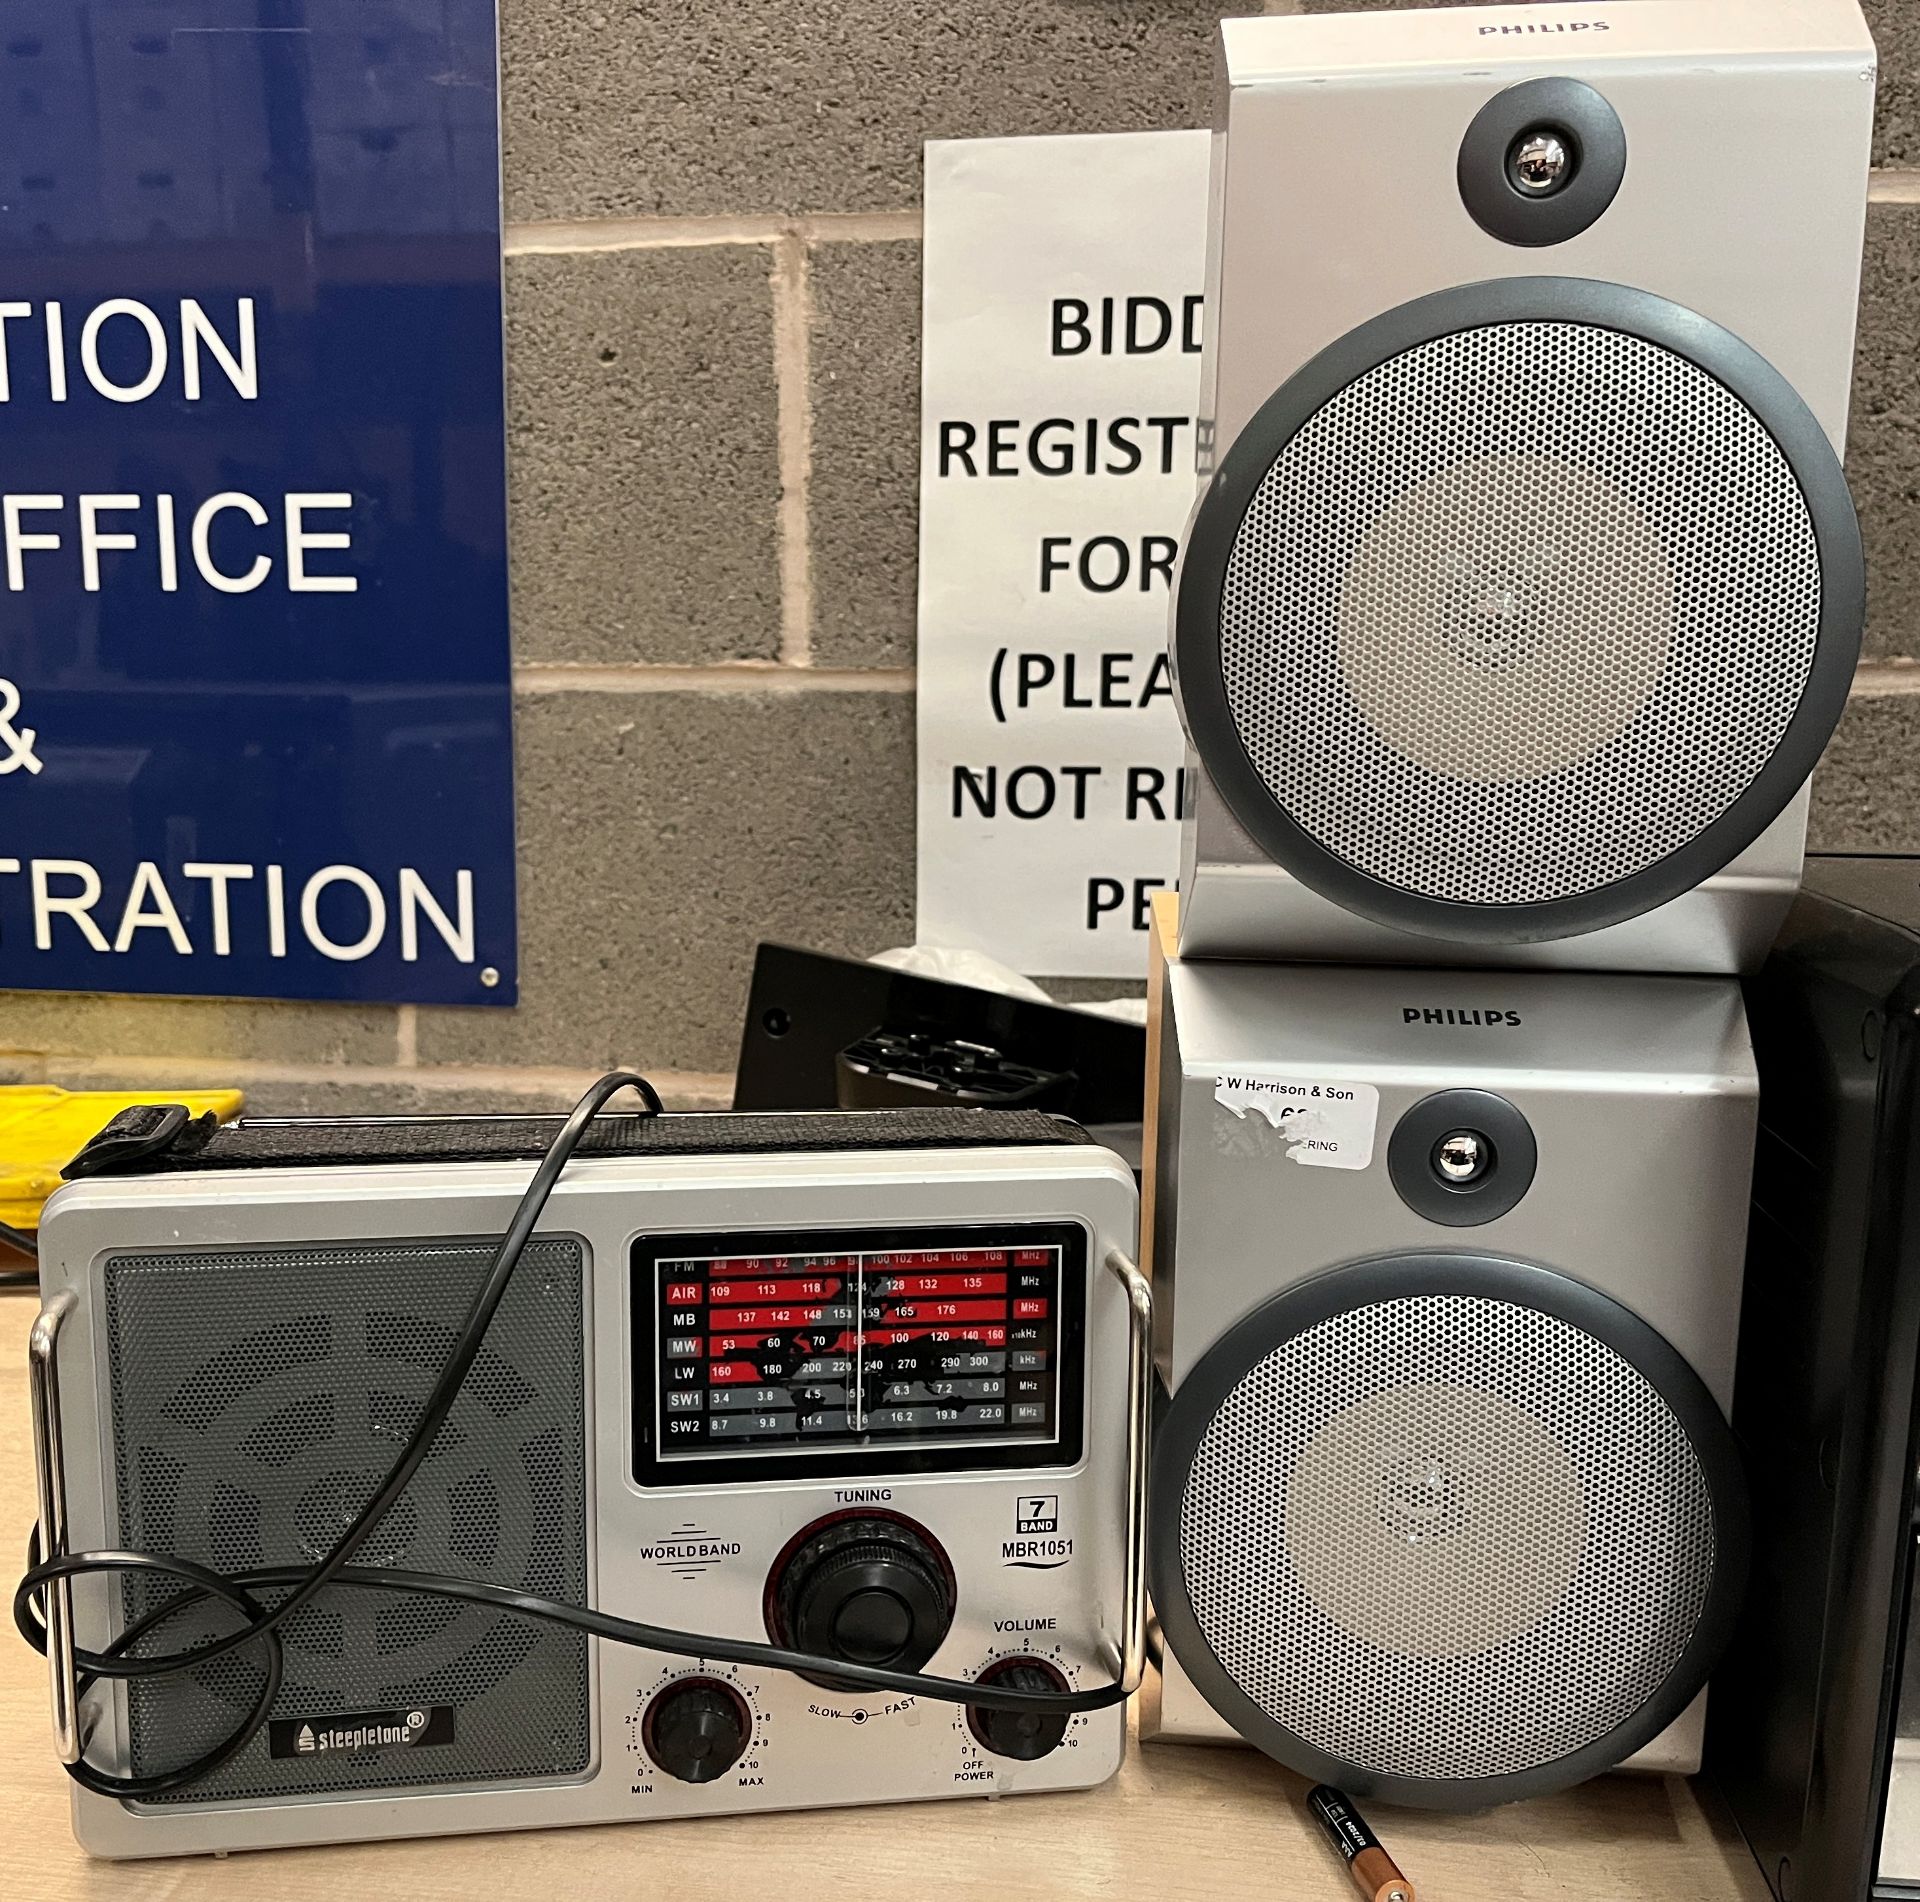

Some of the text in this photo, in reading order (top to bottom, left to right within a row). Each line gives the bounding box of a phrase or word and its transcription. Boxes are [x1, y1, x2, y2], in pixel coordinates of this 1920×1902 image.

[1479, 21, 1610, 35] PHILIPS
[938, 416, 1201, 478] REGIST
[3, 492, 358, 592] FFICE
[951, 766, 1184, 820] NOT R
[0, 858, 475, 962] RATION
[1087, 878, 1179, 930] PE
[1403, 1008, 1521, 1026] PHILIPS
[1227, 1077, 1241, 1089] W
[1245, 1079, 1306, 1096] Harrison
[1311, 1086, 1321, 1097] &
[1326, 1087, 1354, 1100] Son
[922, 1252, 940, 1263] 104
[951, 1252, 969, 1262] 106
[985, 1250, 1003, 1261] 108
[671, 1286, 697, 1300] AIR
[710, 1286, 730, 1297] 109
[758, 1285, 776, 1295] 113
[802, 1283, 821, 1293] 118
[886, 1280, 905, 1291] 128
[919, 1279, 938, 1289] 132
[963, 1278, 983, 1288] 135
[1021, 1276, 1040, 1287] MHz
[673, 1313, 696, 1326] MB
[737, 1312, 757, 1323] 137
[771, 1311, 790, 1321] 142
[803, 1309, 822, 1320] 148
[895, 1306, 914, 1317] 165
[936, 1305, 956, 1315] 176
[1020, 1303, 1039, 1313] MHz
[672, 1340, 697, 1353] MW
[722, 1340, 736, 1350] 53
[767, 1338, 781, 1348] 60
[813, 1336, 826, 1346] 70
[890, 1333, 909, 1343] 100
[930, 1331, 950, 1342] 120
[962, 1331, 979, 1340] 140
[987, 1329, 1004, 1340] 160
[674, 1354, 1036, 1380] LW 160 180 200 220 240 270 290 300 kHz
[671, 1393, 699, 1406] SW1
[713, 1392, 730, 1404] 3.4
[757, 1391, 774, 1402] 3.8
[804, 1389, 821, 1400] 4.5
[893, 1385, 910, 1396] 6.3
[936, 1384, 953, 1395] 7.2
[983, 1382, 1000, 1393] 8.0
[1019, 1381, 1038, 1391] MHz
[670, 1420, 700, 1433] SW2
[711, 1419, 728, 1431] 8.7
[759, 1417, 776, 1428] 9.8
[801, 1415, 823, 1427] 11.4
[891, 1411, 913, 1423] 16.2
[935, 1409, 958, 1421] 19.8
[979, 1408, 1002, 1420] 22.0
[1019, 1407, 1038, 1417] MHz
[834, 1488, 892, 1503] TUNING
[1030, 1501, 1045, 1517] 7
[1020, 1521, 1054, 1532] BAND
[1002, 1539, 1073, 1558] MBR1051
[994, 1618, 1057, 1632] VOLUME
[1023, 1637, 1030, 1647] 5
[987, 1646, 994, 1655] 4
[1055, 1644, 1061, 1653] 6
[661, 1667, 668, 1676] 4
[732, 1665, 738, 1673] 6
[963, 1669, 968, 1677] 3
[1076, 1665, 1082, 1674] 7
[636, 1689, 642, 1697] 3
[754, 1685, 760, 1694] 7
[808, 1697, 917, 1719] SLOW FAST
[625, 1715, 631, 1724] 2
[765, 1713, 771, 1722] 8
[1082, 1717, 1088, 1726] 9
[319, 1725, 409, 1751] steepletone
[762, 1738, 769, 1747] 9
[1068, 1738, 1078, 1748] 10
[748, 1760, 759, 1769] 10
[962, 1760, 984, 1770] OFF
[637, 1768, 644, 1777] 0
[954, 1771, 994, 1782] POWER
[738, 1776, 764, 1787] MAX
[631, 1784, 653, 1794] MIN
